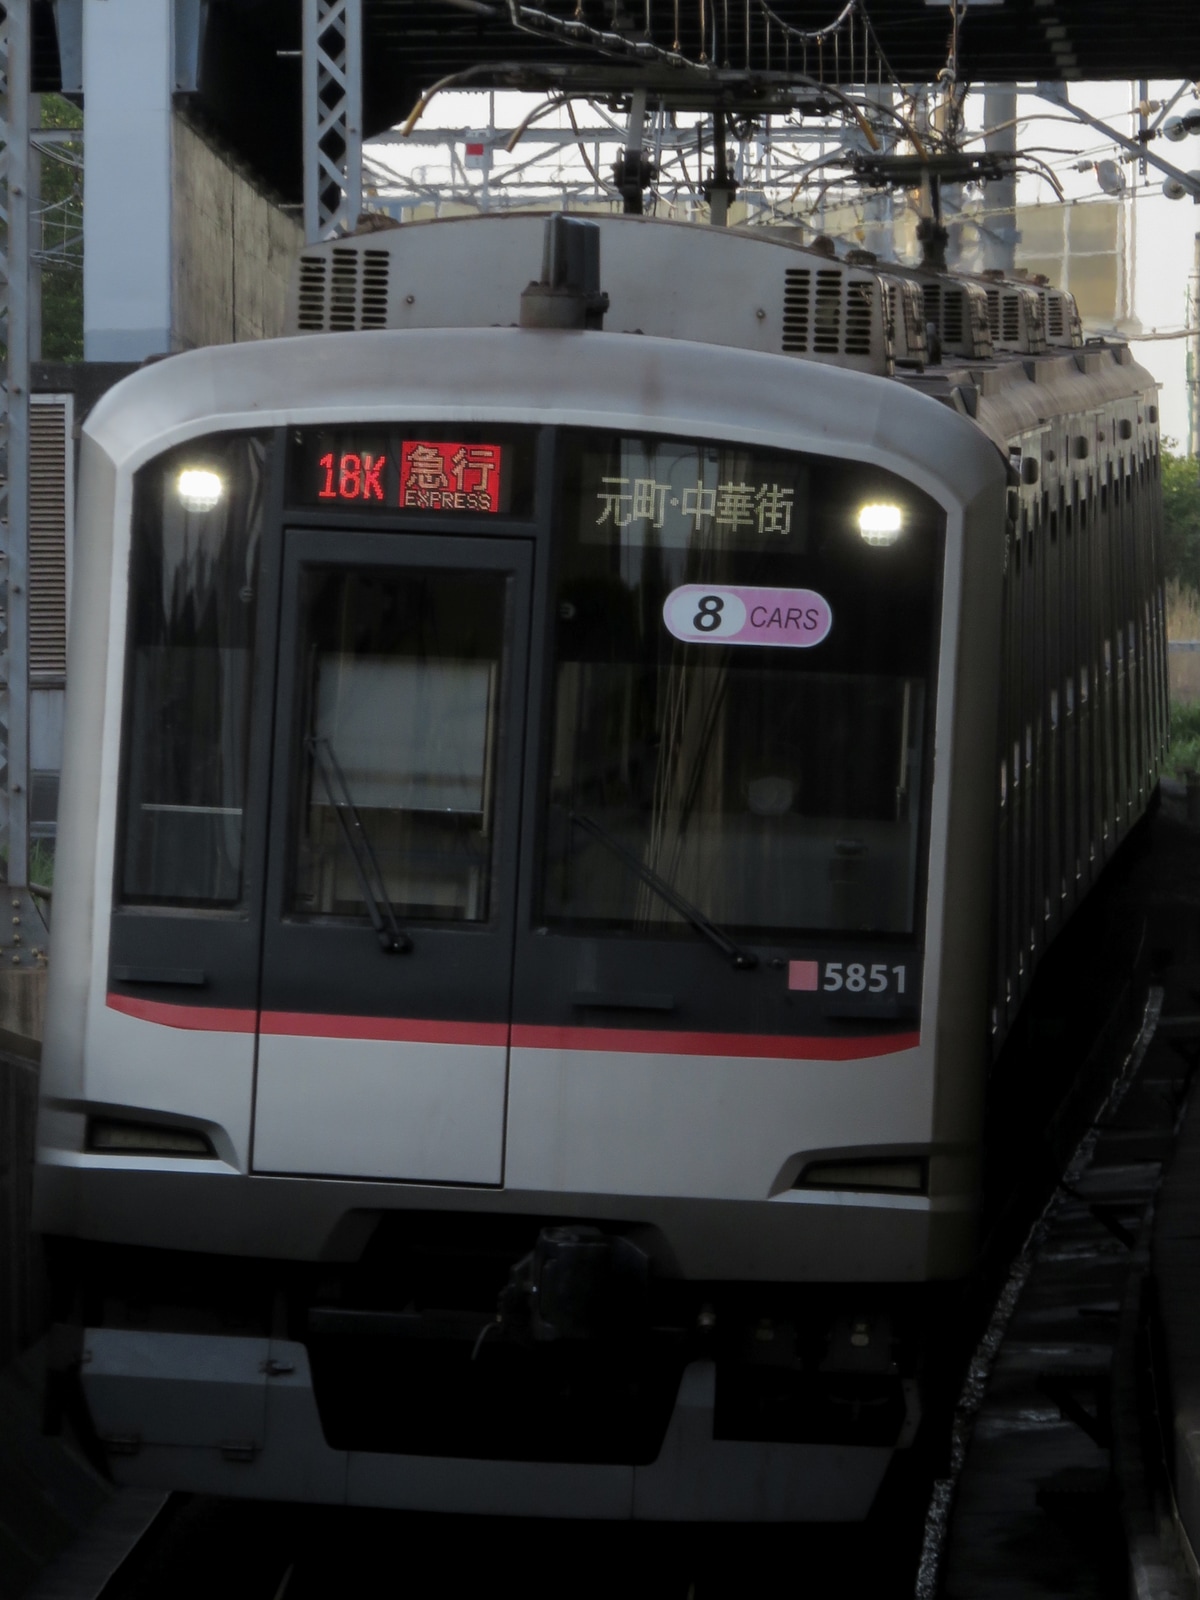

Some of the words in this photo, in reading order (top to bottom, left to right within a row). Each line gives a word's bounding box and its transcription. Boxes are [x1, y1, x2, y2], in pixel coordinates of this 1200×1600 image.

[318, 453, 386, 500] 18K
[405, 445, 495, 491] 急行
[405, 490, 491, 510] EXPRESS
[693, 595, 724, 632] 8
[750, 606, 819, 630] CARS
[823, 962, 906, 993] 5851
